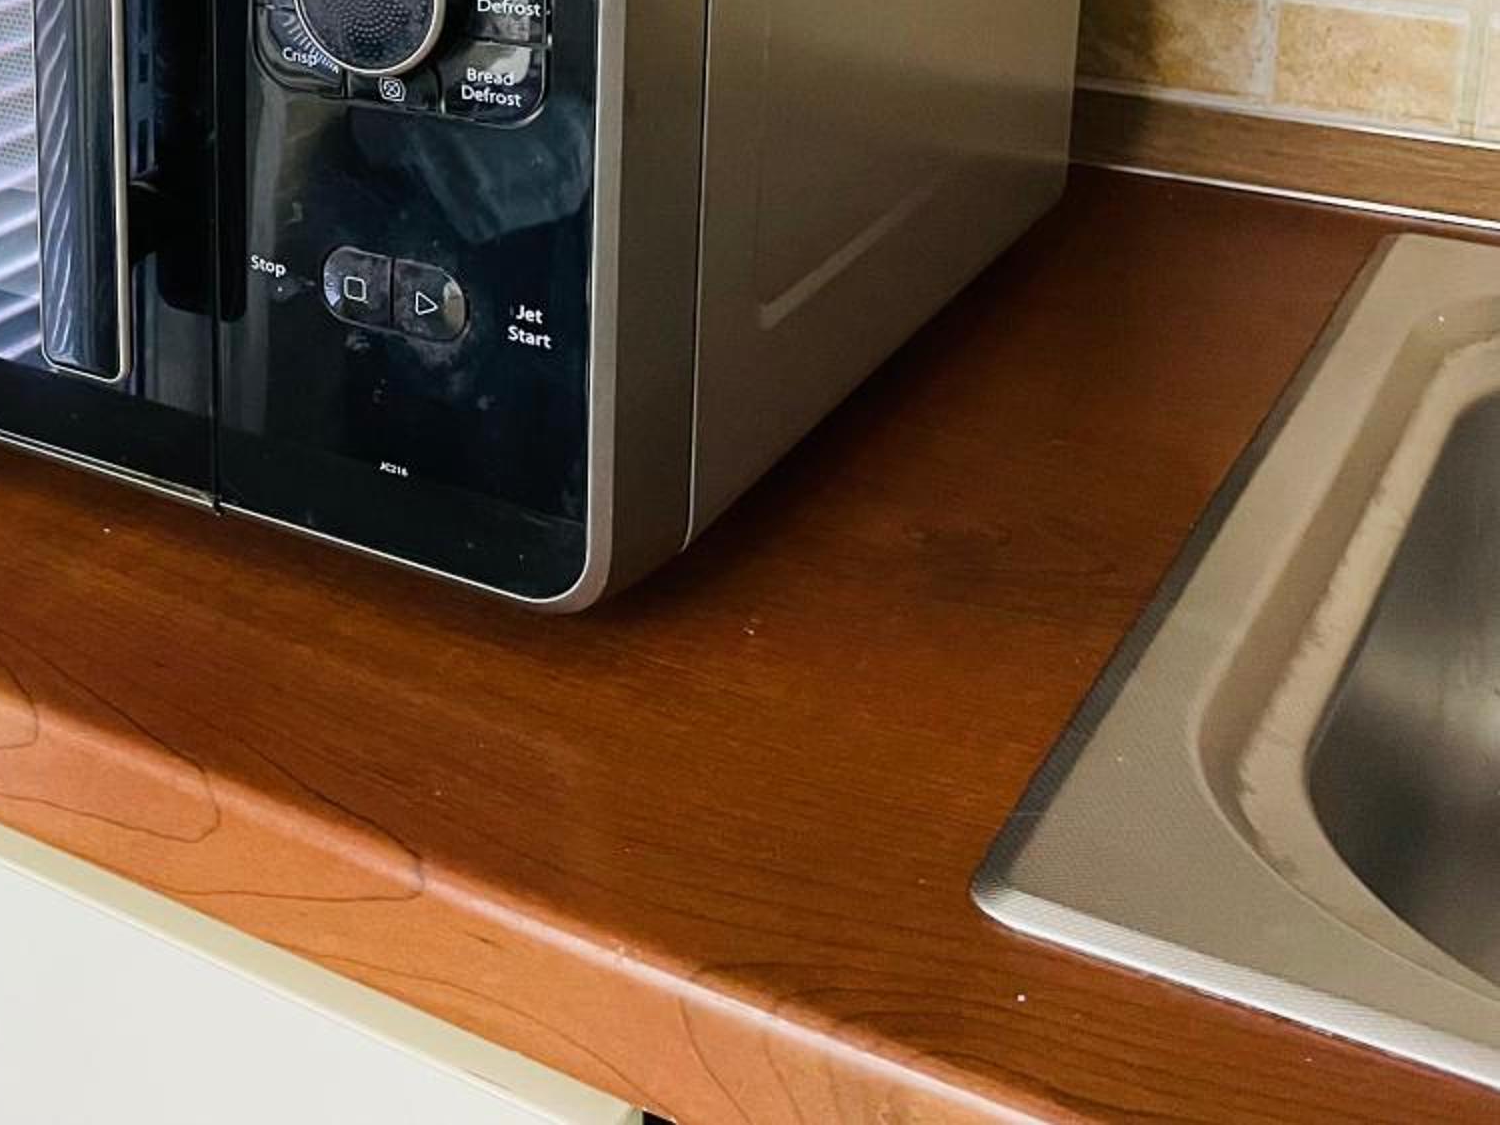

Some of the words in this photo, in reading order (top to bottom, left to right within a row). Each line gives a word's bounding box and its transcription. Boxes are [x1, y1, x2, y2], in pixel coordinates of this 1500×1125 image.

[281, 45, 318, 67] Crisp
[466, 66, 515, 87] Bread
[460, 84, 523, 108] Defrost
[250, 254, 287, 277] Stop
[514, 304, 544, 325] Jet
[507, 325, 553, 350] Start
